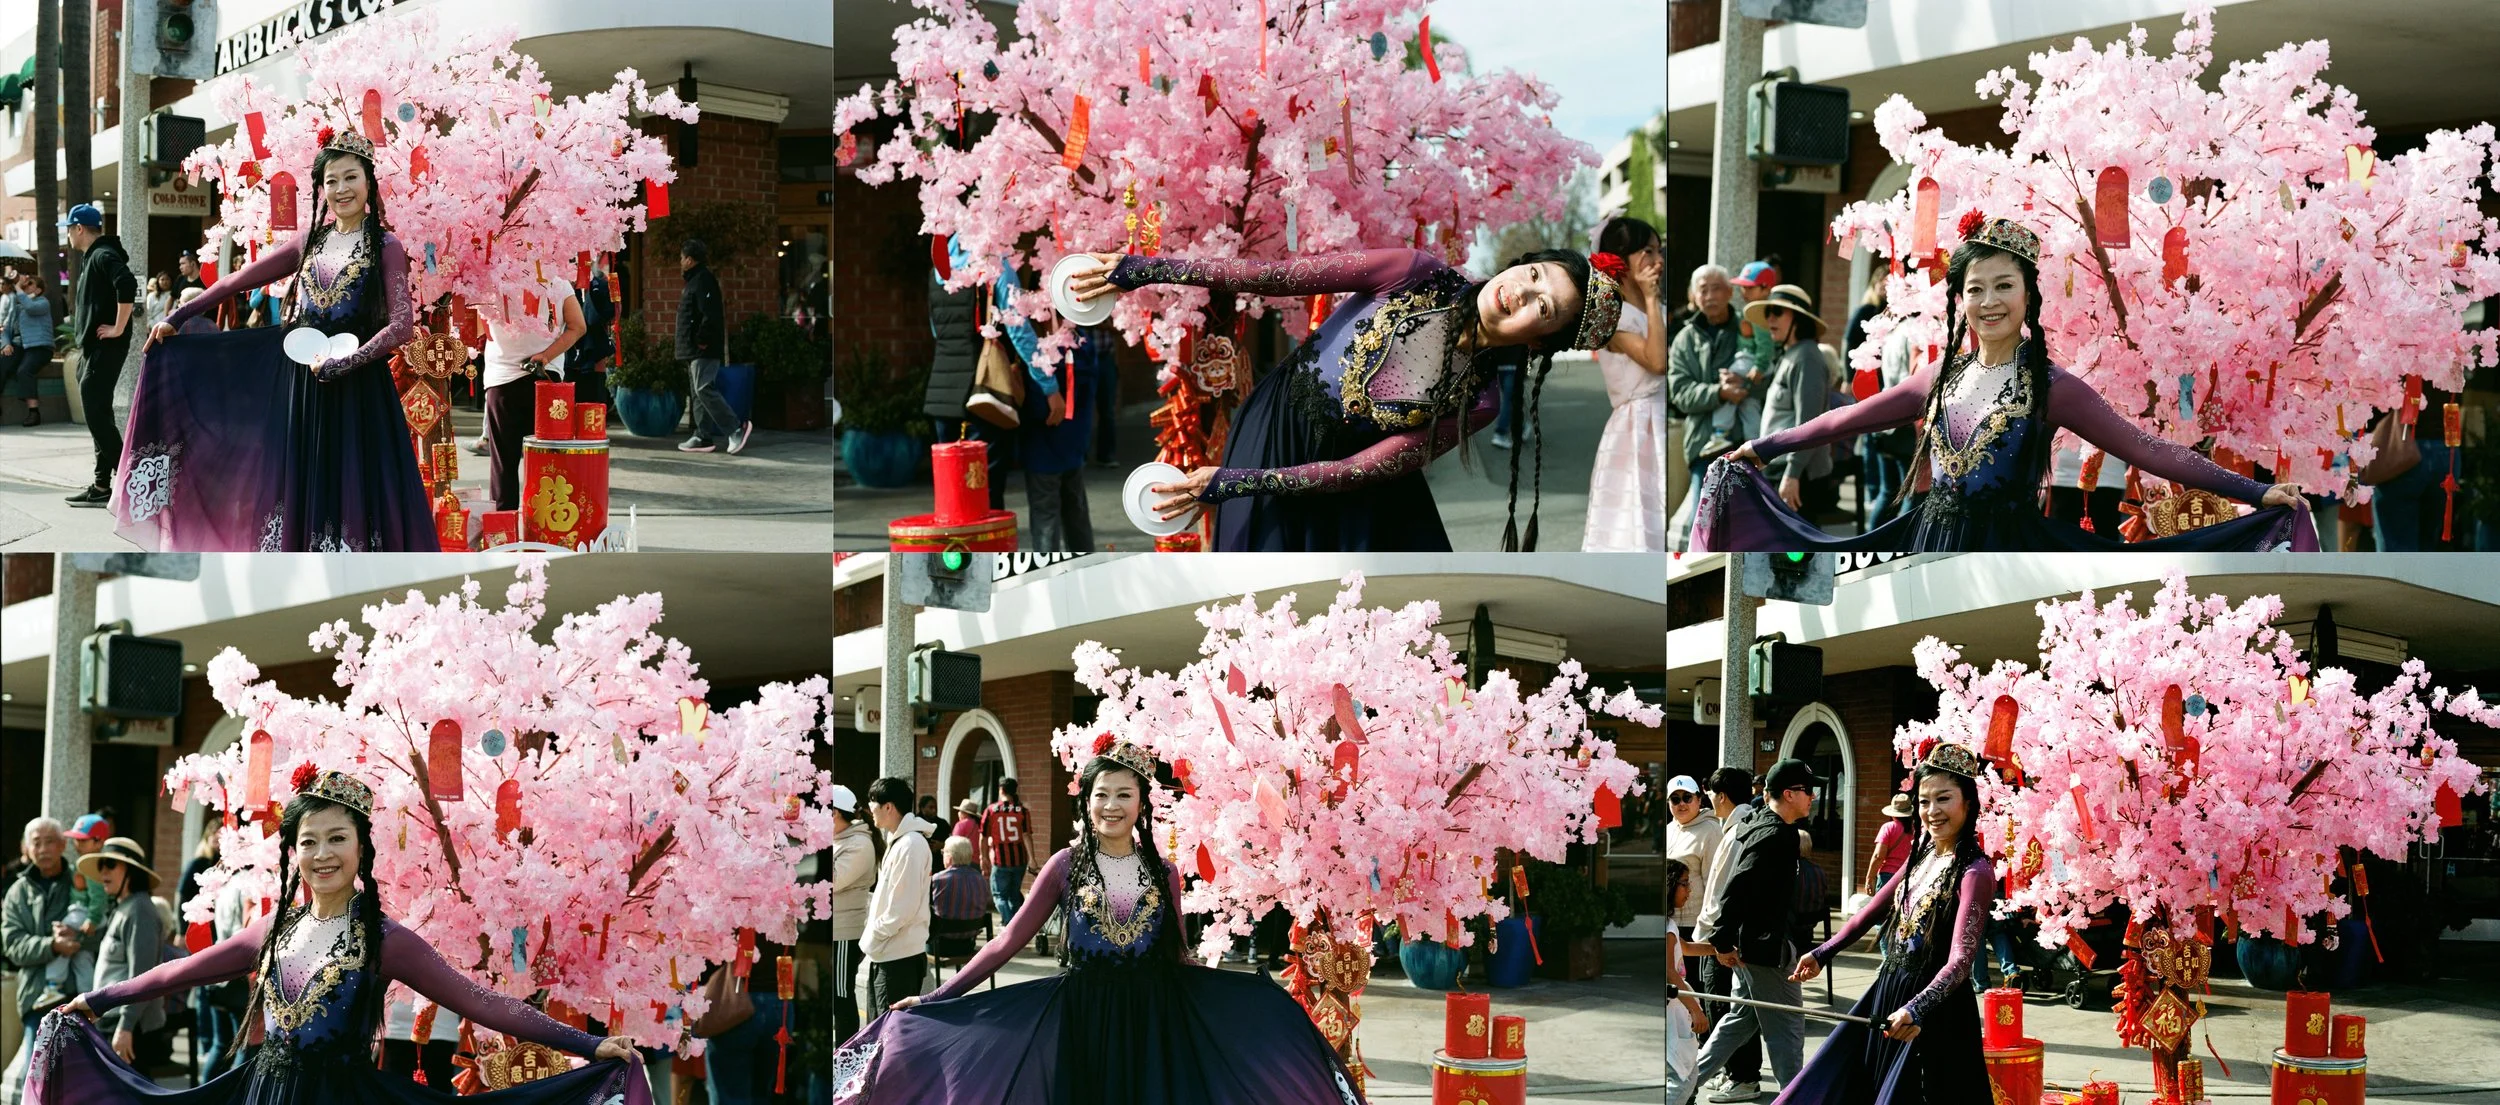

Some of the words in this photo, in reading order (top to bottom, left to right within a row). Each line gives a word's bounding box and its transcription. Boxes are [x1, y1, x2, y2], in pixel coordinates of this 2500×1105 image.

[153, 192, 177, 206] COLD
[178, 193, 207, 207] STONE
[409, 392, 435, 421] 福
[530, 474, 580, 533] 福
[997, 816, 1020, 842] 15
[1317, 1006, 1344, 1038] 福
[2154, 1003, 2182, 1035] 福
